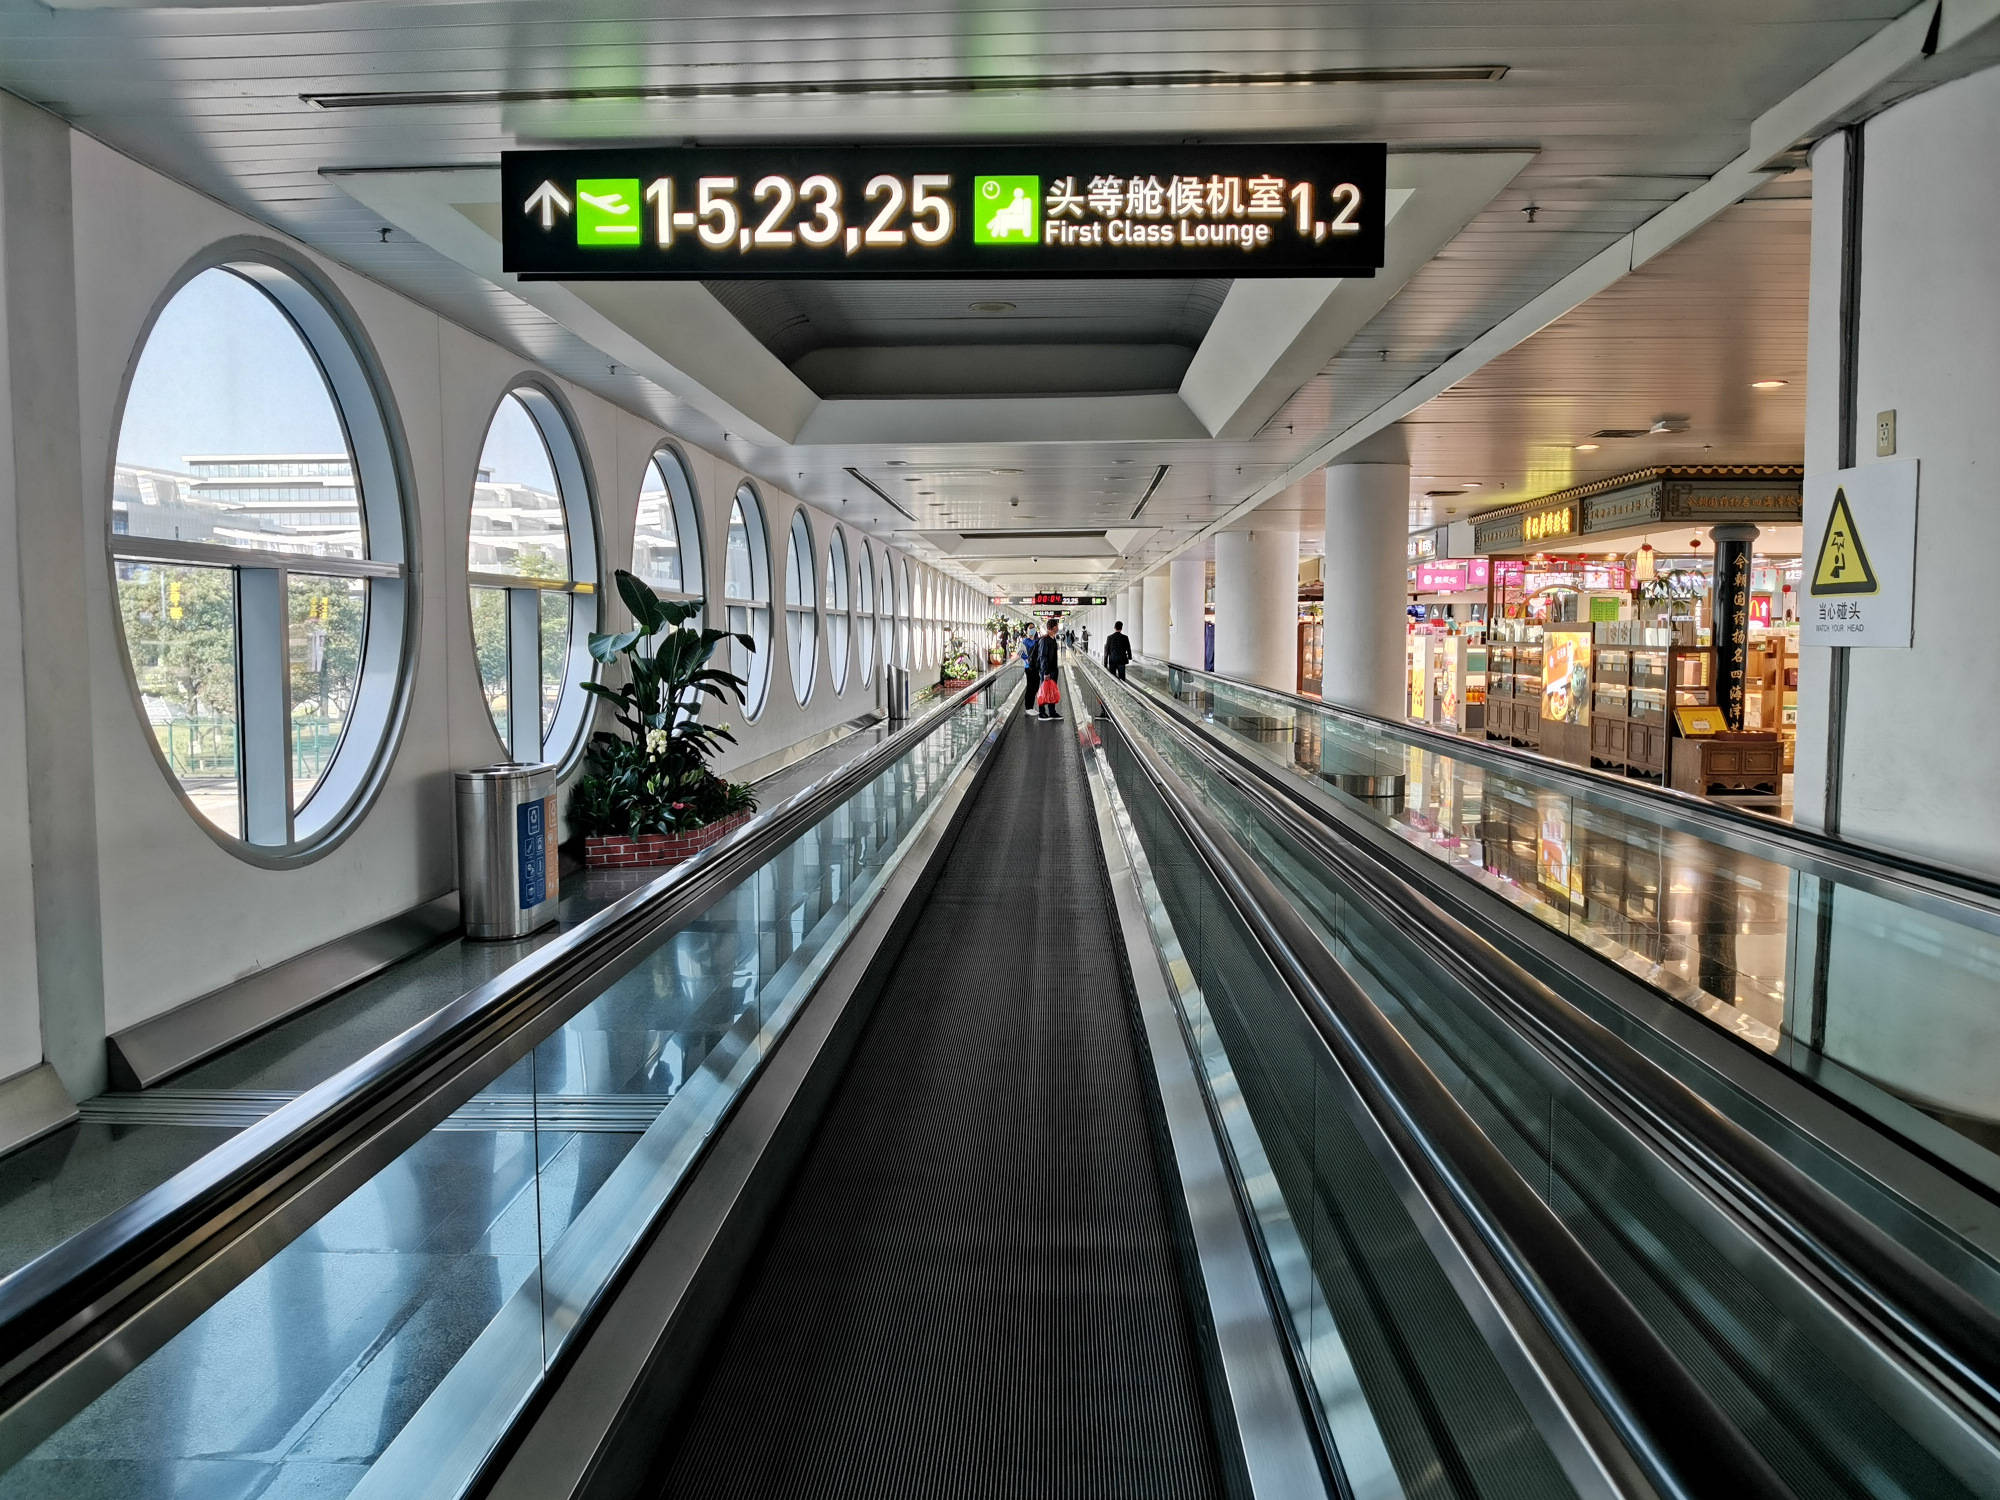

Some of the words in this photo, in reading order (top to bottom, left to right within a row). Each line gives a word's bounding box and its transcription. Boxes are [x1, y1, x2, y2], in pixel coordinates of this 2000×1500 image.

[1046, 175, 1284, 216] 头等舱候机室
[1289, 182, 1361, 243] 1,2
[646, 174, 951, 254] 1-5,23,25
[1046, 219, 1101, 243] First
[1108, 219, 1173, 243] Class
[1181, 219, 1269, 250] Lounge
[1819, 601, 1861, 620] 当心碰头
[1847, 624, 1865, 632] HEAD
